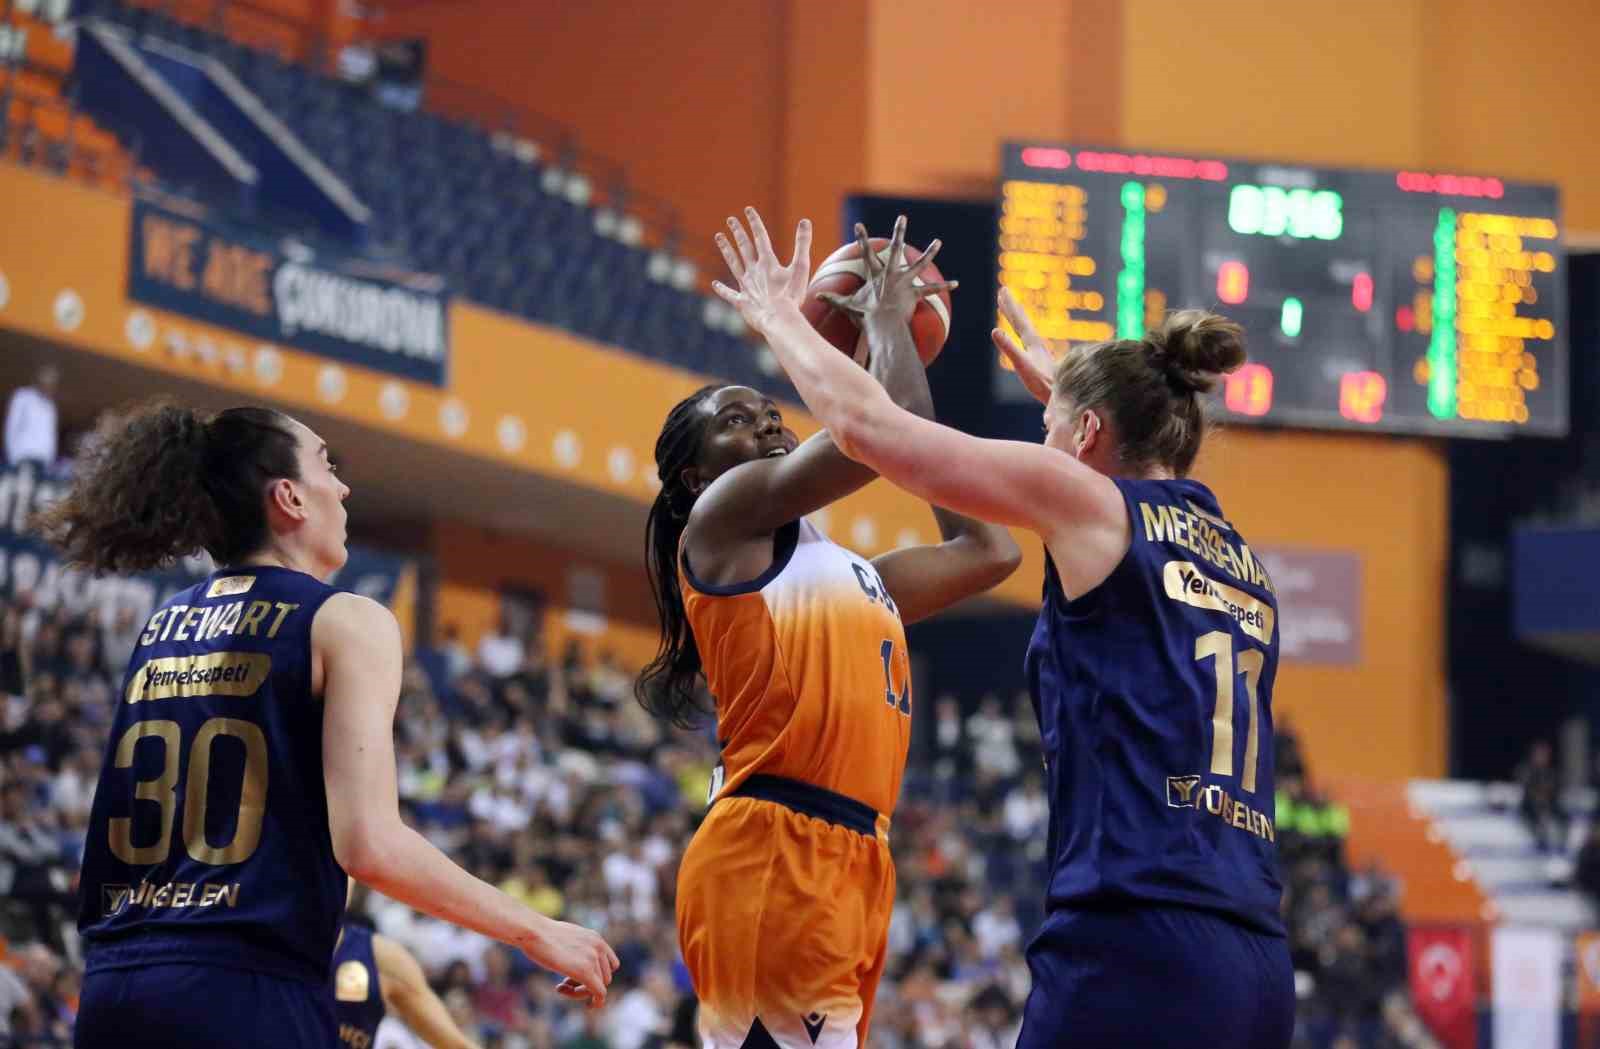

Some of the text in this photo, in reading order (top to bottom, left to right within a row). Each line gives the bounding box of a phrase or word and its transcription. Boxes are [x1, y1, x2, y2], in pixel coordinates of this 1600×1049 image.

[140, 600, 300, 646] STEWART
[143, 663, 250, 692] Yemeksepeti
[1195, 631, 1264, 793] 11
[108, 717, 268, 865] 30
